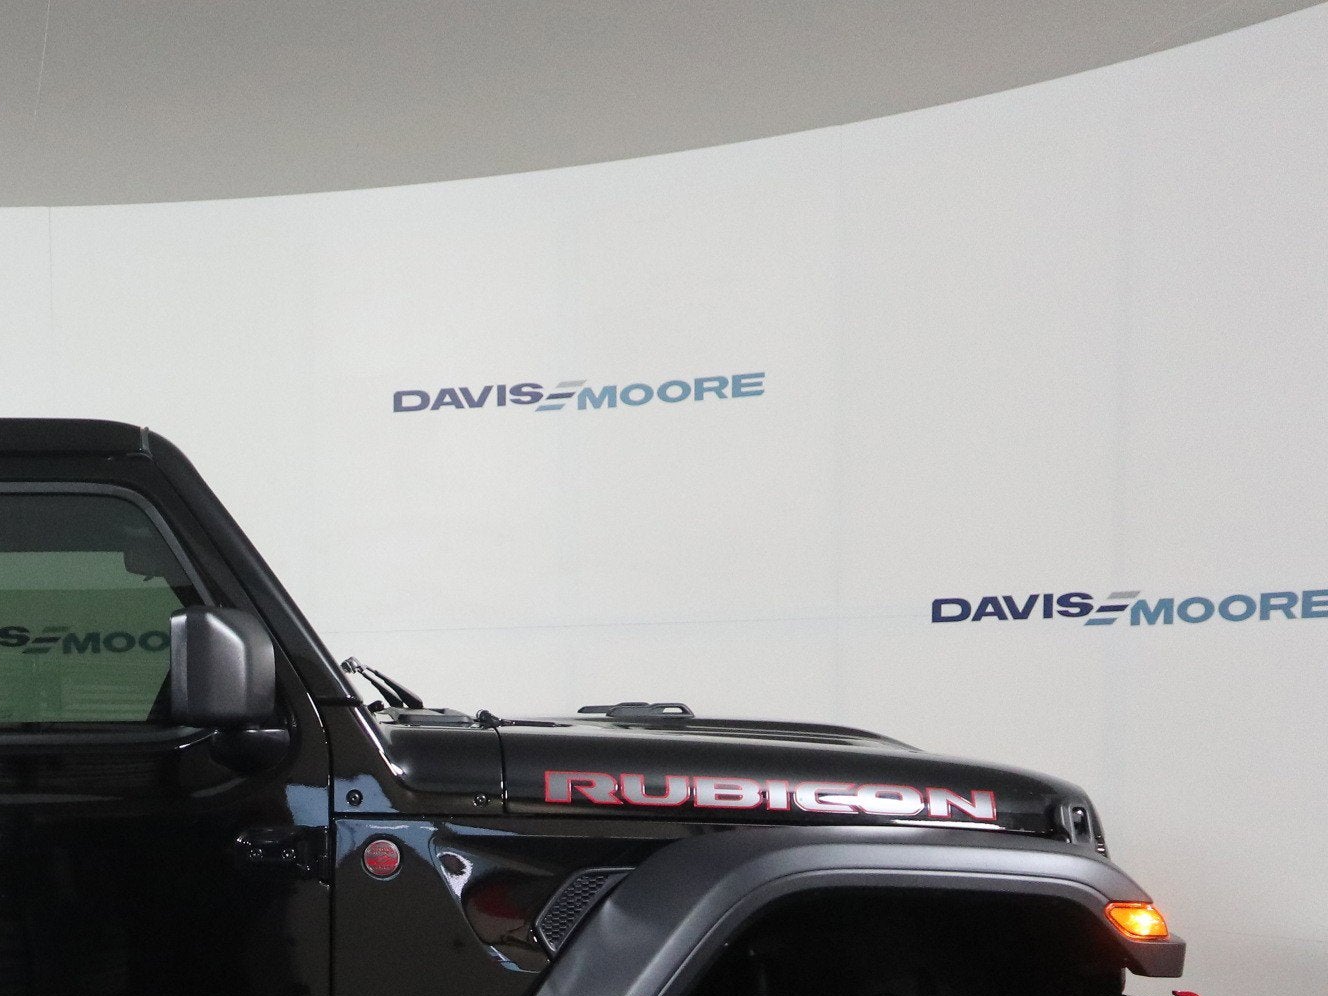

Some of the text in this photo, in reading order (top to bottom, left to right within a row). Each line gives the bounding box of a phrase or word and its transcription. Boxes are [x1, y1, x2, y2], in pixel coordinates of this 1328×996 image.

[393, 372, 765, 412] DAVIS MOORE
[931, 591, 1093, 623] DAVIS
[63, 630, 171, 654] MOO
[544, 770, 998, 821] RUBICON
